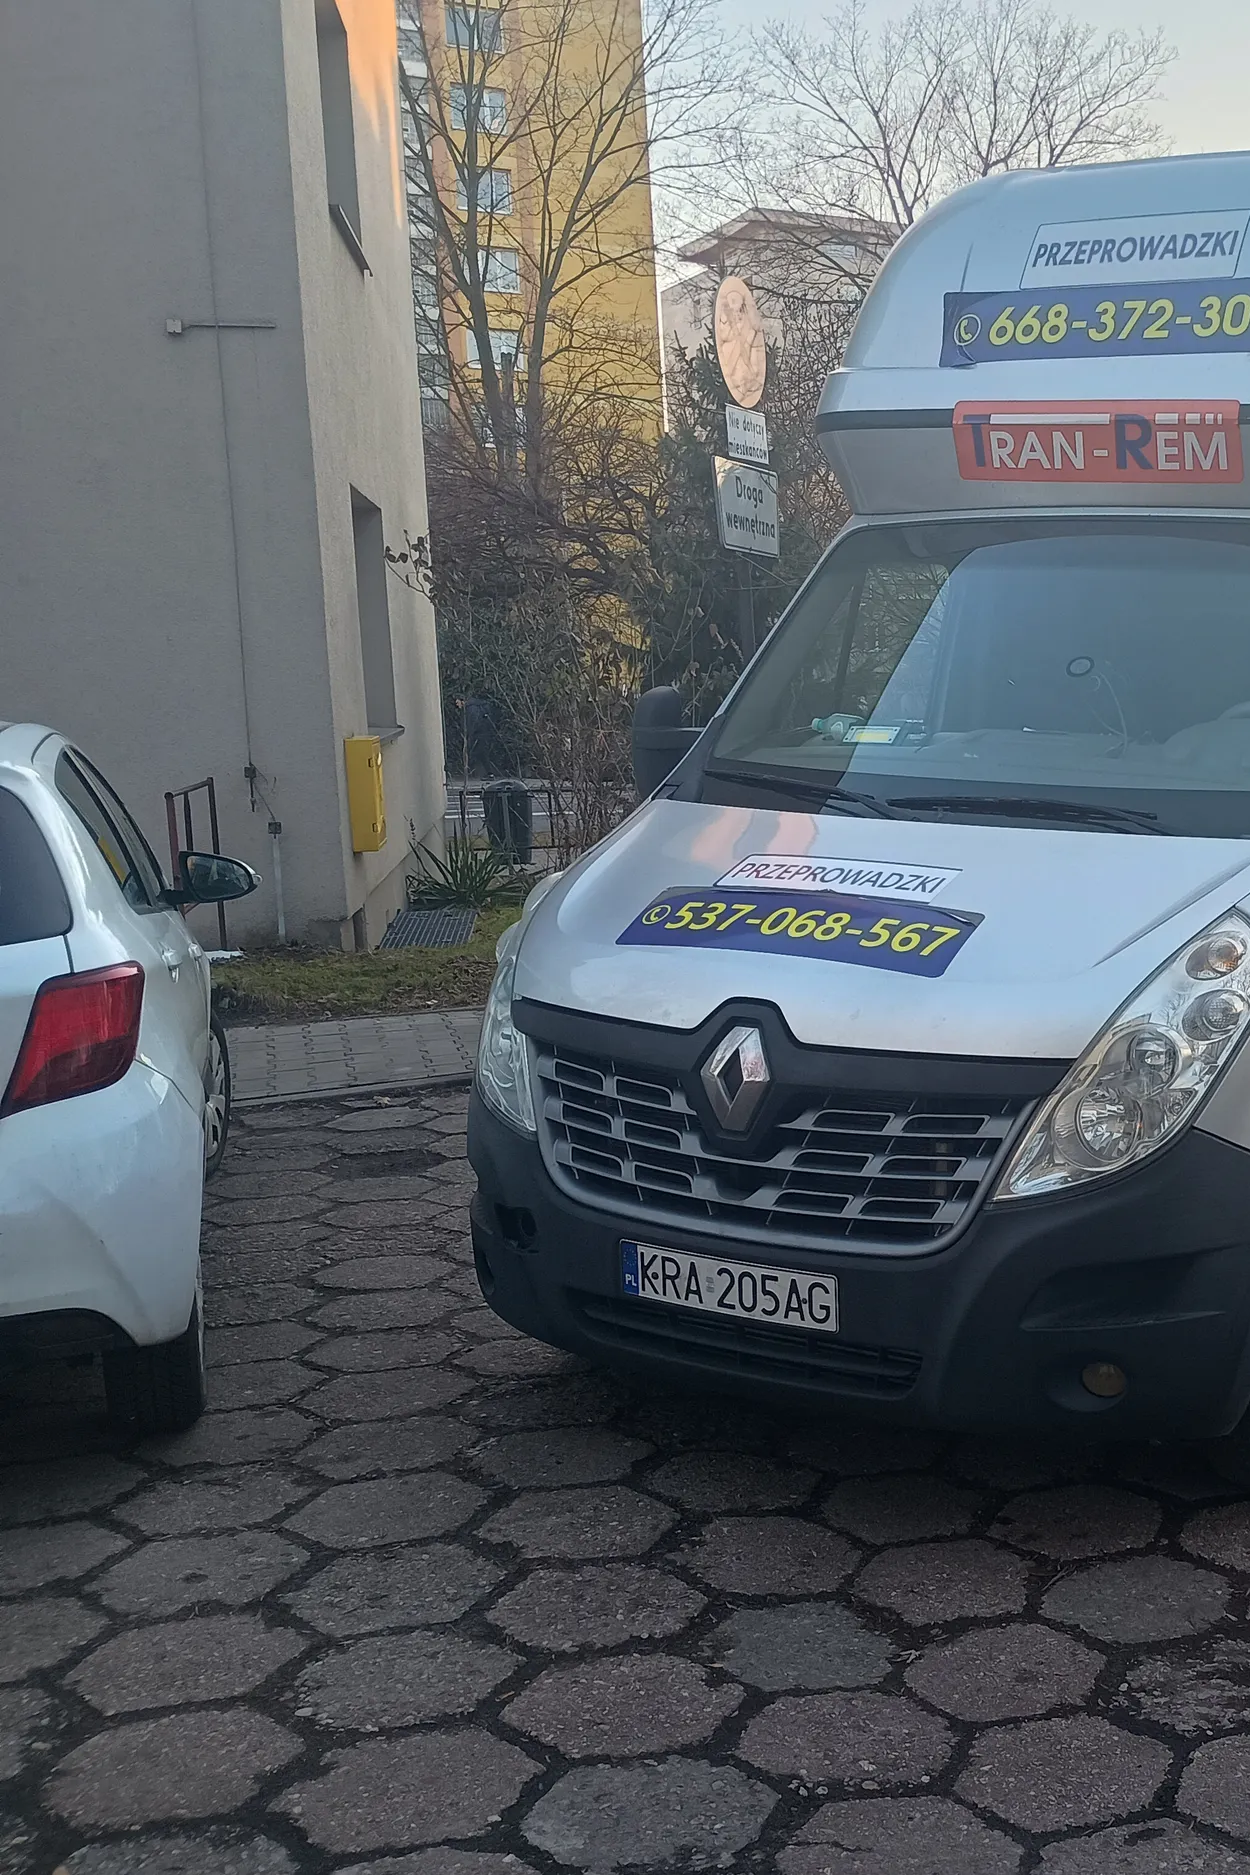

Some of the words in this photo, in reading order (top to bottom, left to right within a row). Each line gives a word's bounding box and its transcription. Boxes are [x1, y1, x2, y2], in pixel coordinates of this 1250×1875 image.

[1032, 230, 1239, 267] PRZEPROWADZKI
[728, 411, 740, 428] Nie
[742, 414, 765, 439] dotyczy
[735, 475, 764, 508] Droga
[725, 511, 776, 540] wewnętrzna
[731, 862, 947, 894] PRZEPROWADZKI
[665, 902, 961, 956] 537-068-567
[625, 1274, 637, 1287] PL
